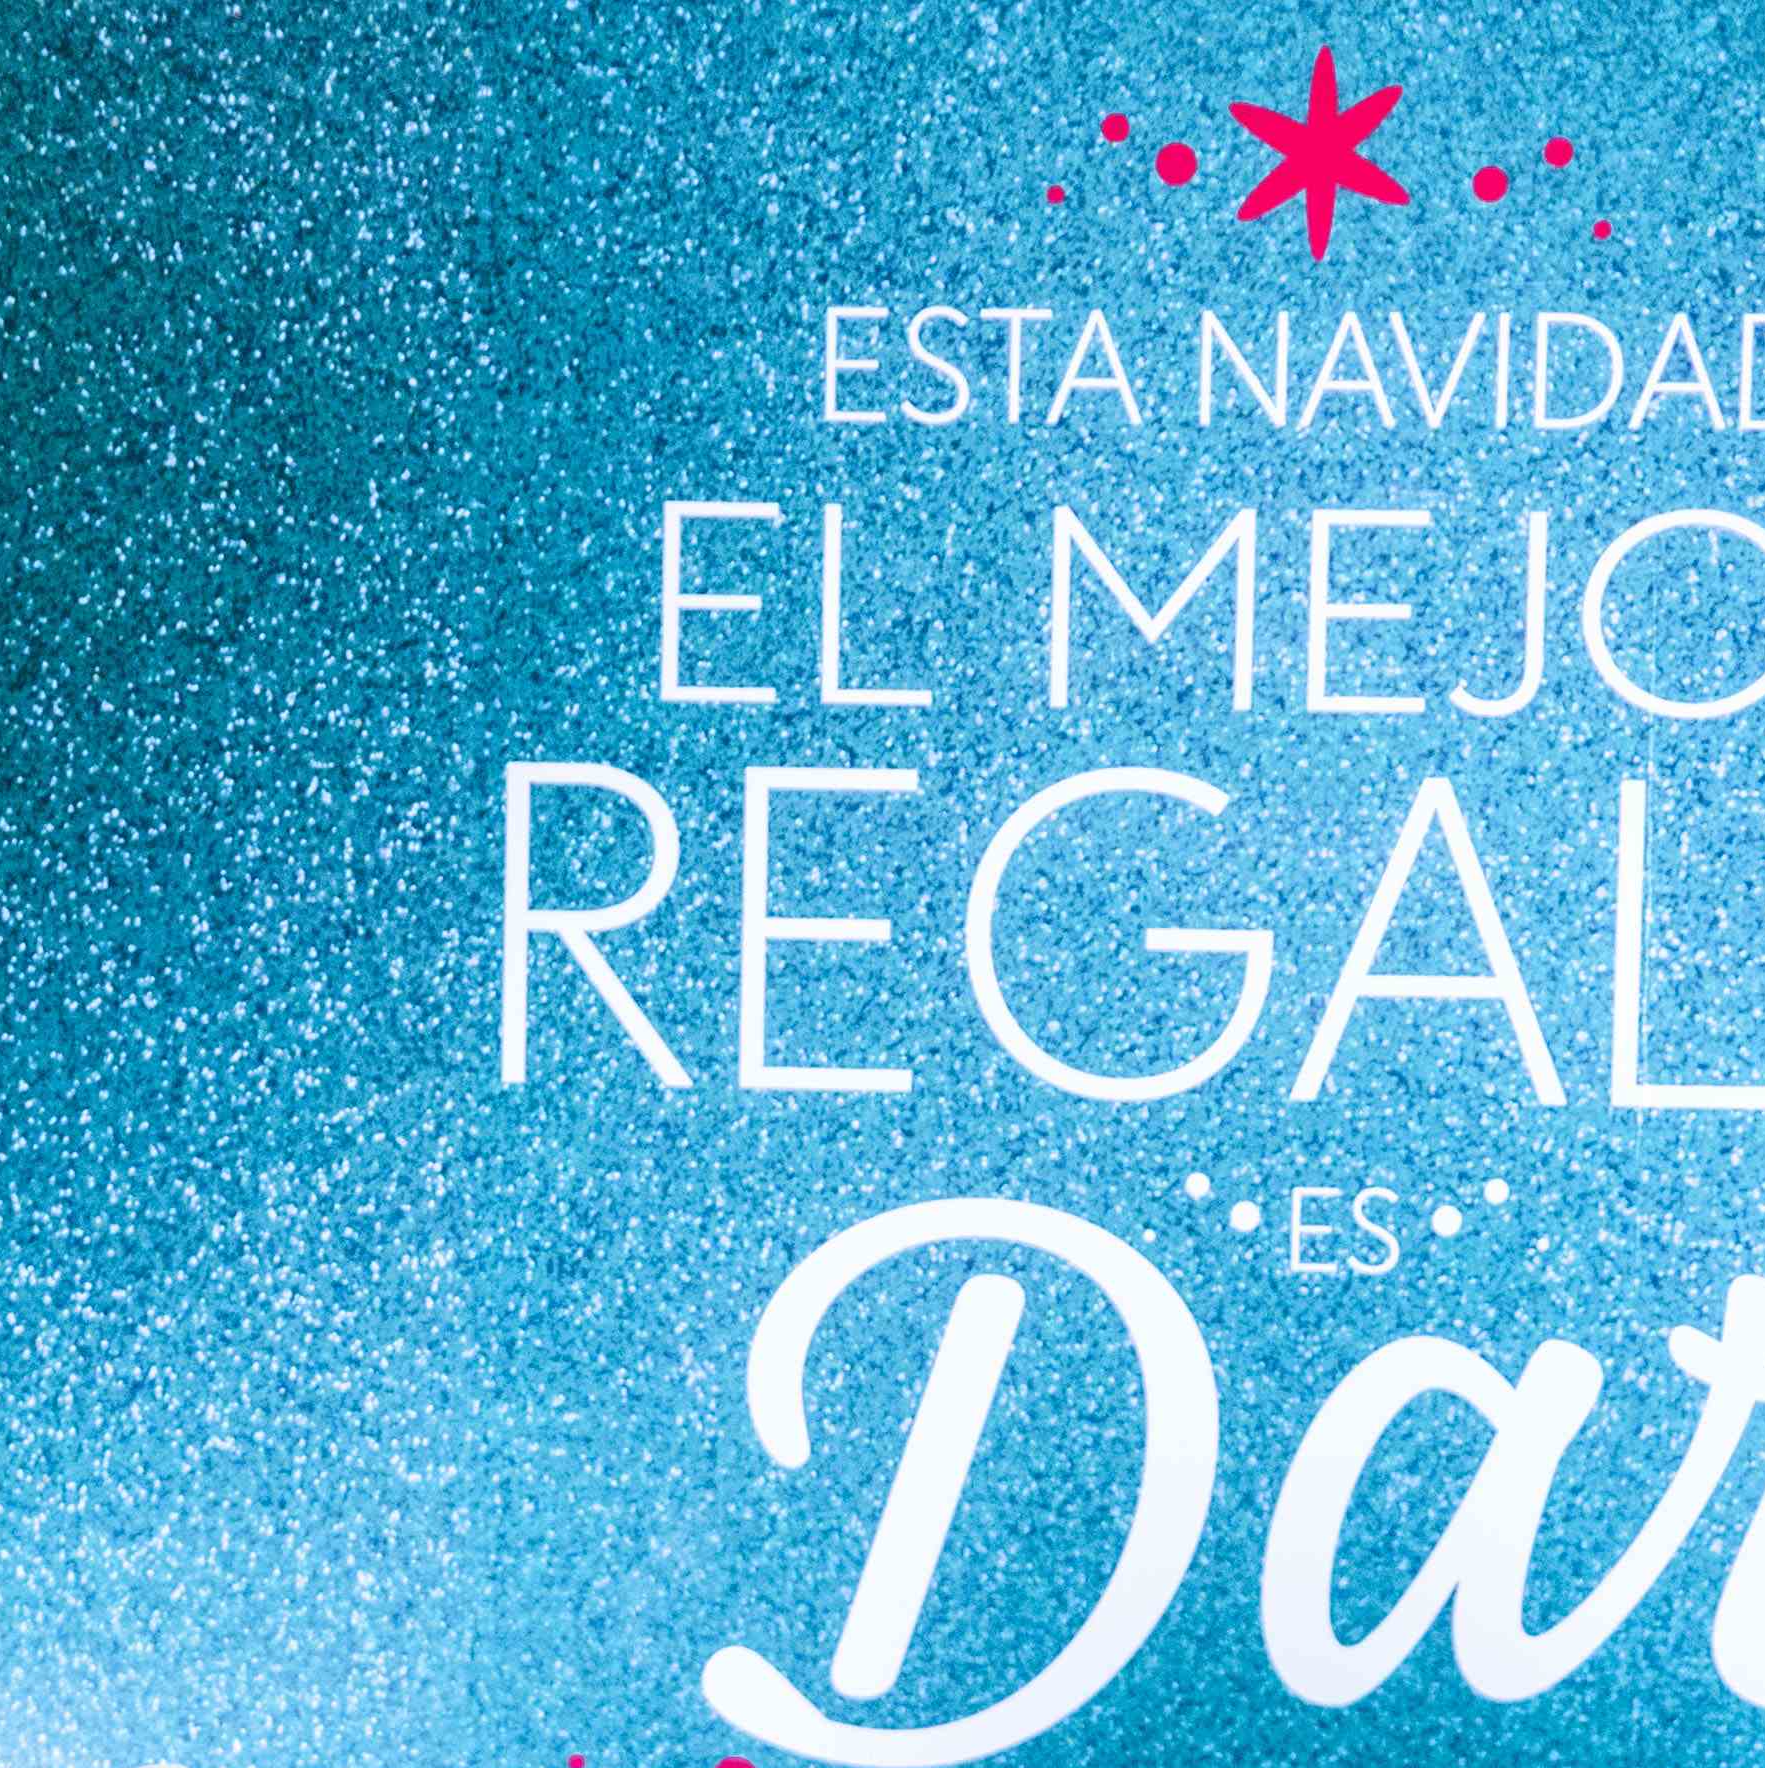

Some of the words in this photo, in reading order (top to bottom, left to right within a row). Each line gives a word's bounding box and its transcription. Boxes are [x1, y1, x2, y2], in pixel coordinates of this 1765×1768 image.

[824, 306, 1142, 424] ESTA
[660, 501, 933, 706] EL
[1290, 1186, 1401, 1275] ES
